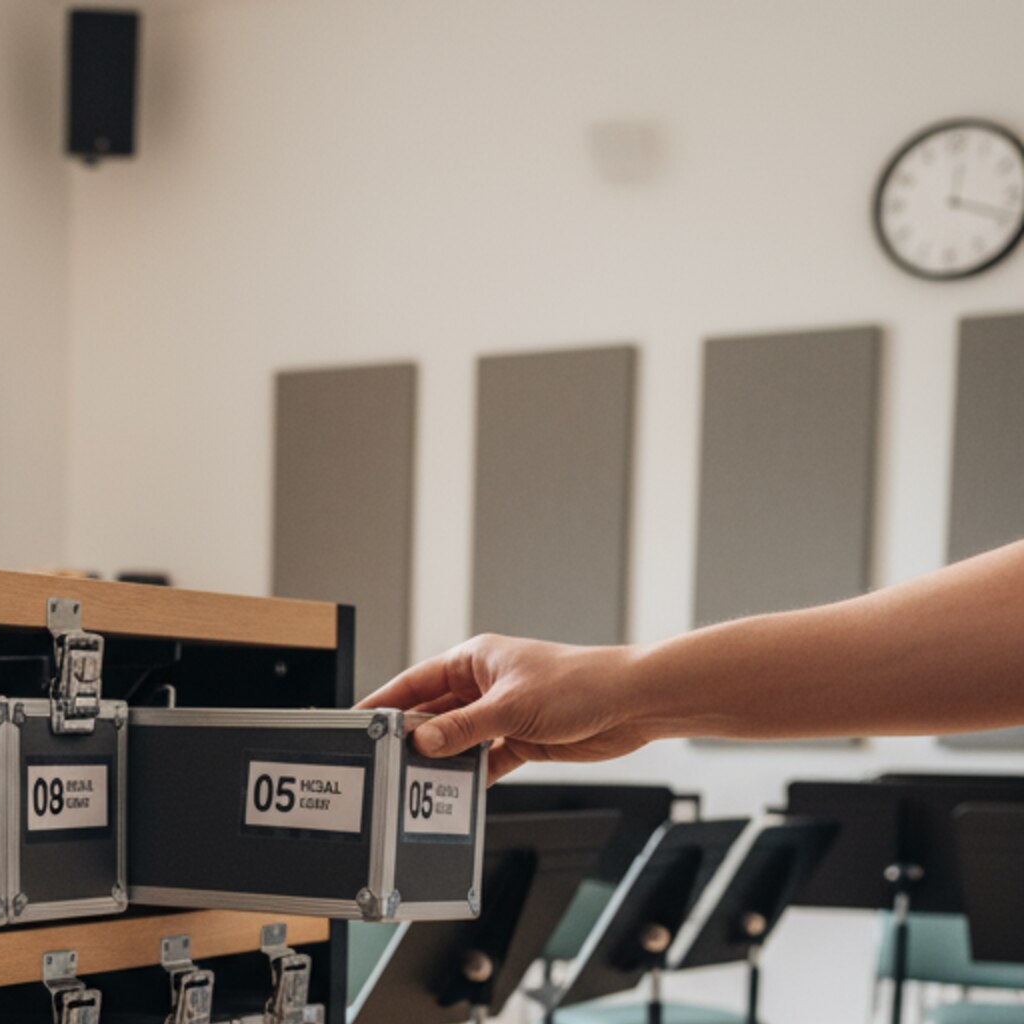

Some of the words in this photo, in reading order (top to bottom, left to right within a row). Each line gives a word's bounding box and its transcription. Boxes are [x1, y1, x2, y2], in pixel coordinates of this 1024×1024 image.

[33, 777, 64, 817] 08
[253, 773, 297, 813] 05
[409, 780, 433, 819] 05
